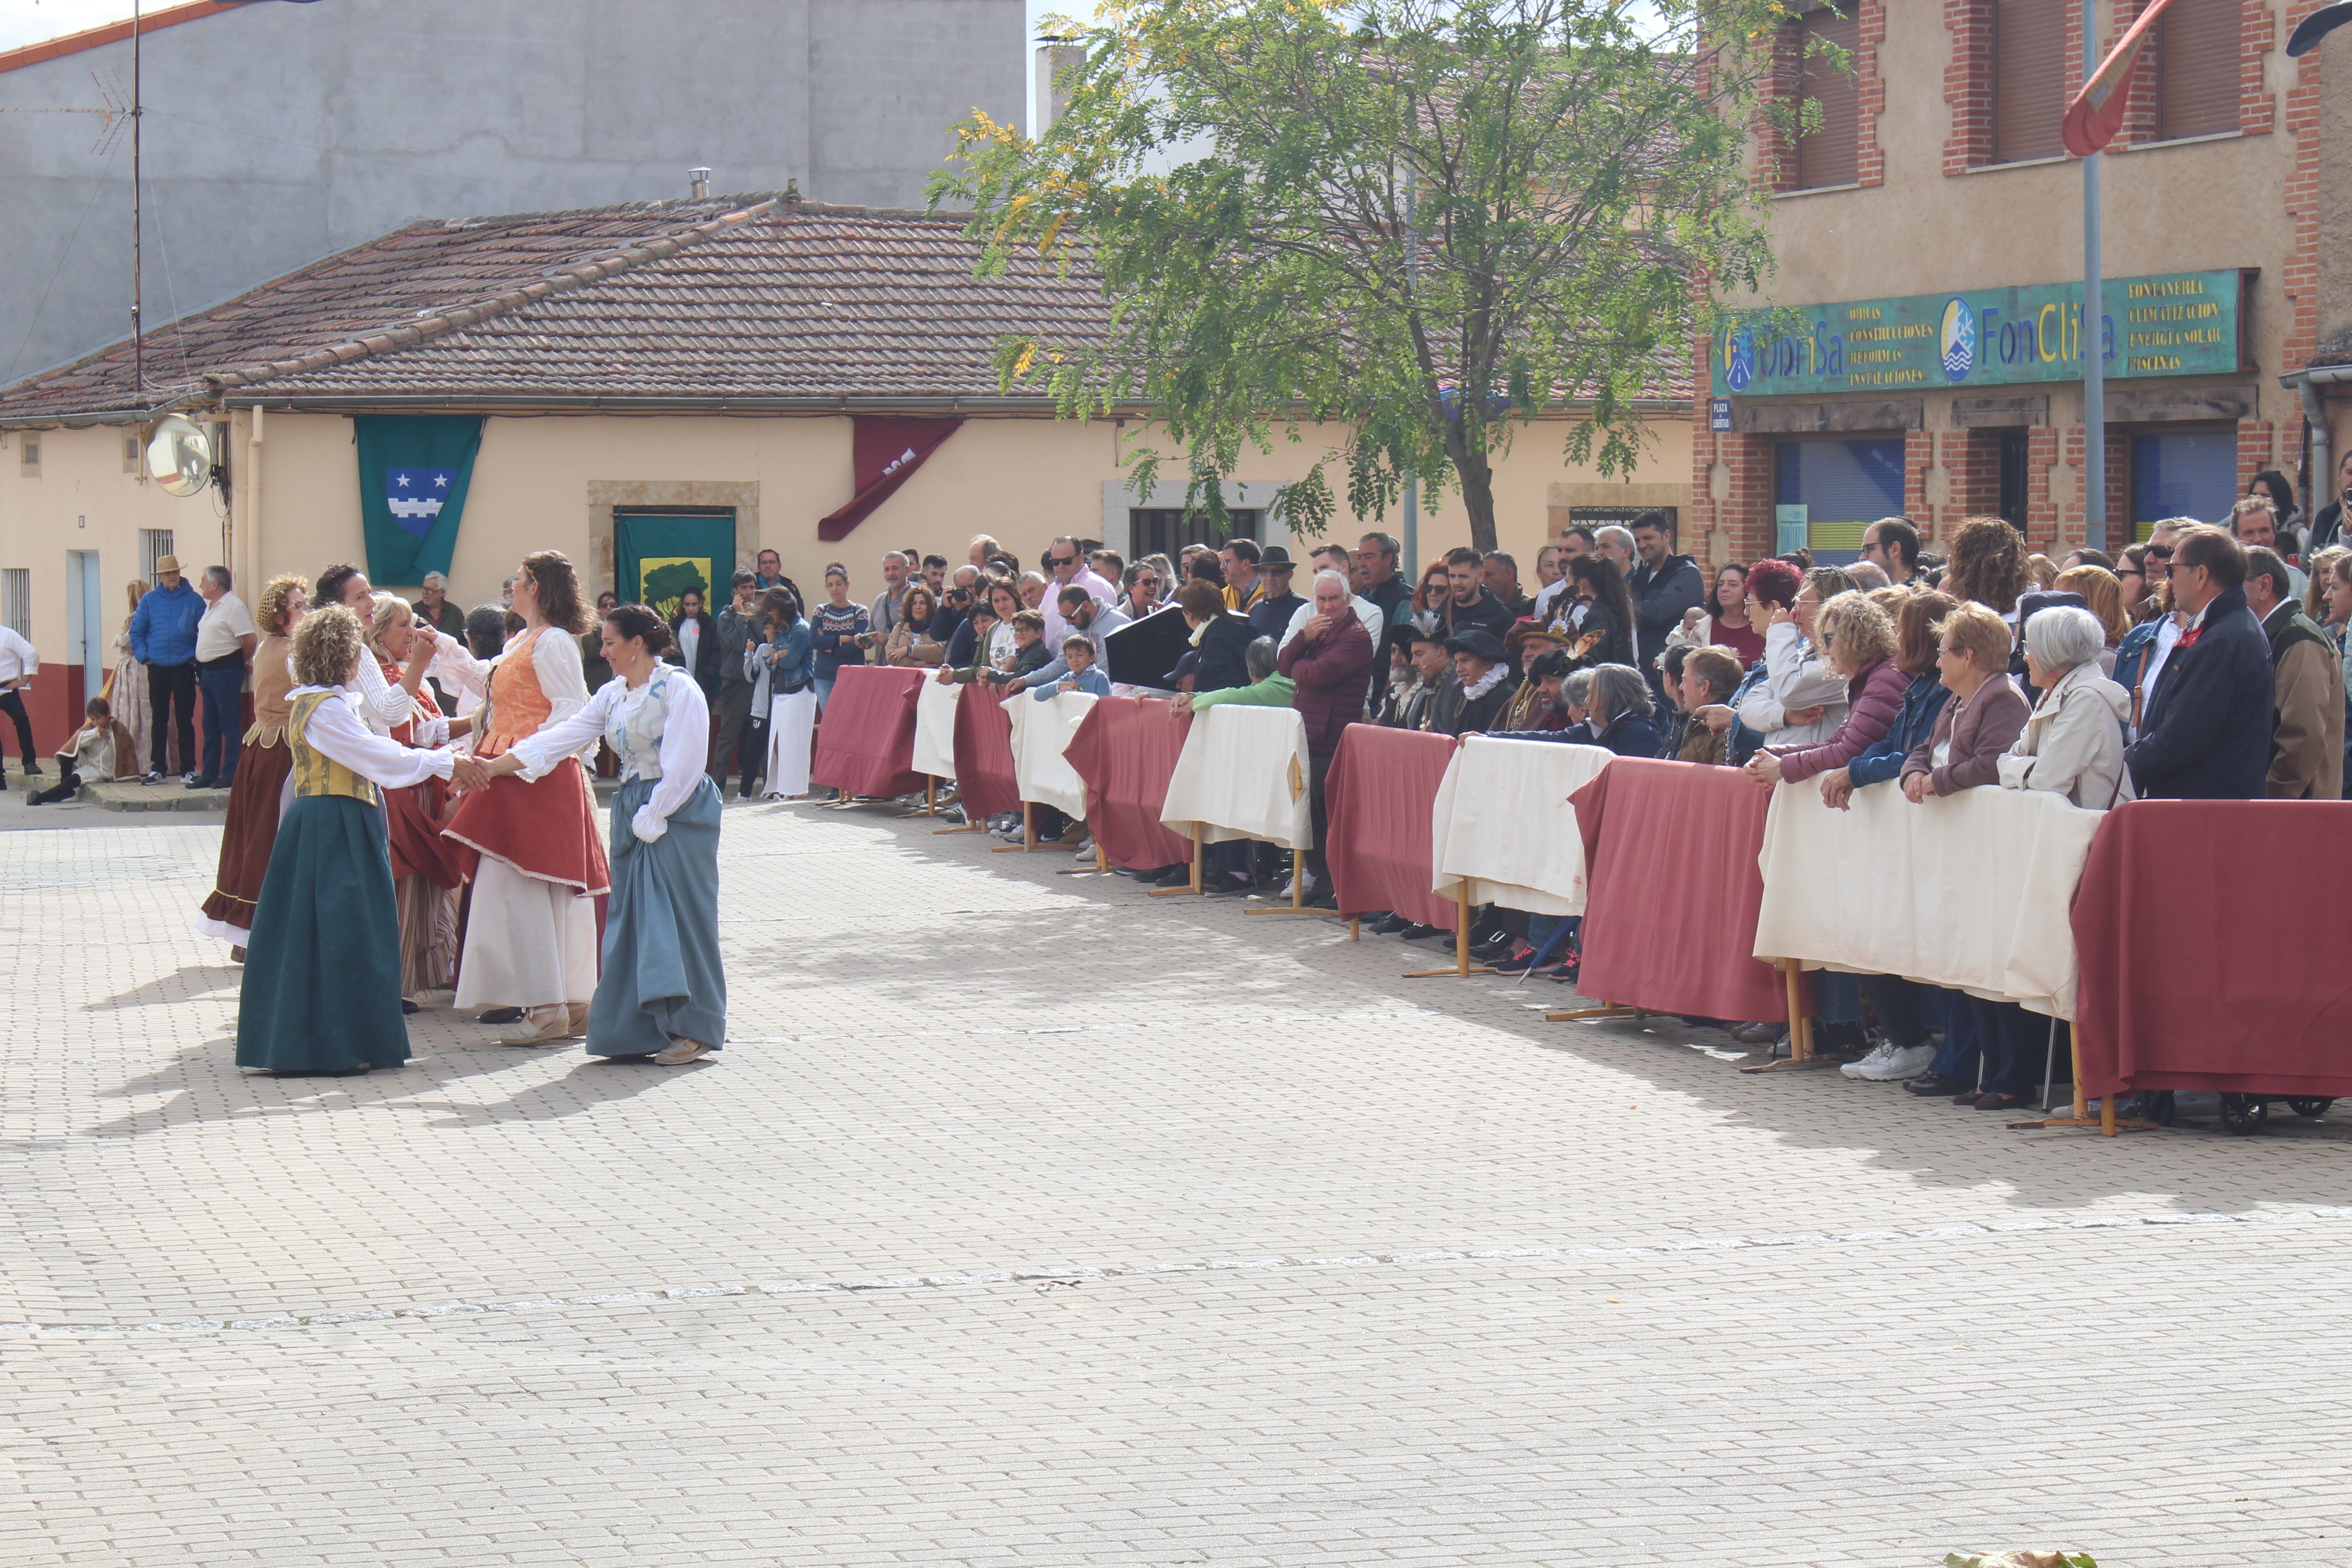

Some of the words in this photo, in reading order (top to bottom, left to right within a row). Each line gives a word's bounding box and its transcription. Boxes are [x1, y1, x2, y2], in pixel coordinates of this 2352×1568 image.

[2128, 280, 2203, 299] FONTANERIA
[1850, 306, 1881, 320] OBRAS
[2129, 303, 2219, 323] CLIMATIZACION
[1850, 323, 1933, 343] CONSTRUCCIONES
[1983, 301, 2115, 365] FonClia
[2129, 330, 2180, 347] ENERGIA
[2184, 328, 2221, 343] SOLAR
[1850, 348, 1902, 364] REFORMAS
[2129, 355, 2180, 371] PISCINAS
[1850, 368, 1923, 386] INSTALACIONES
[1714, 403, 1728, 413] PLAZA
[1713, 419, 1729, 428] LIBERTAD
